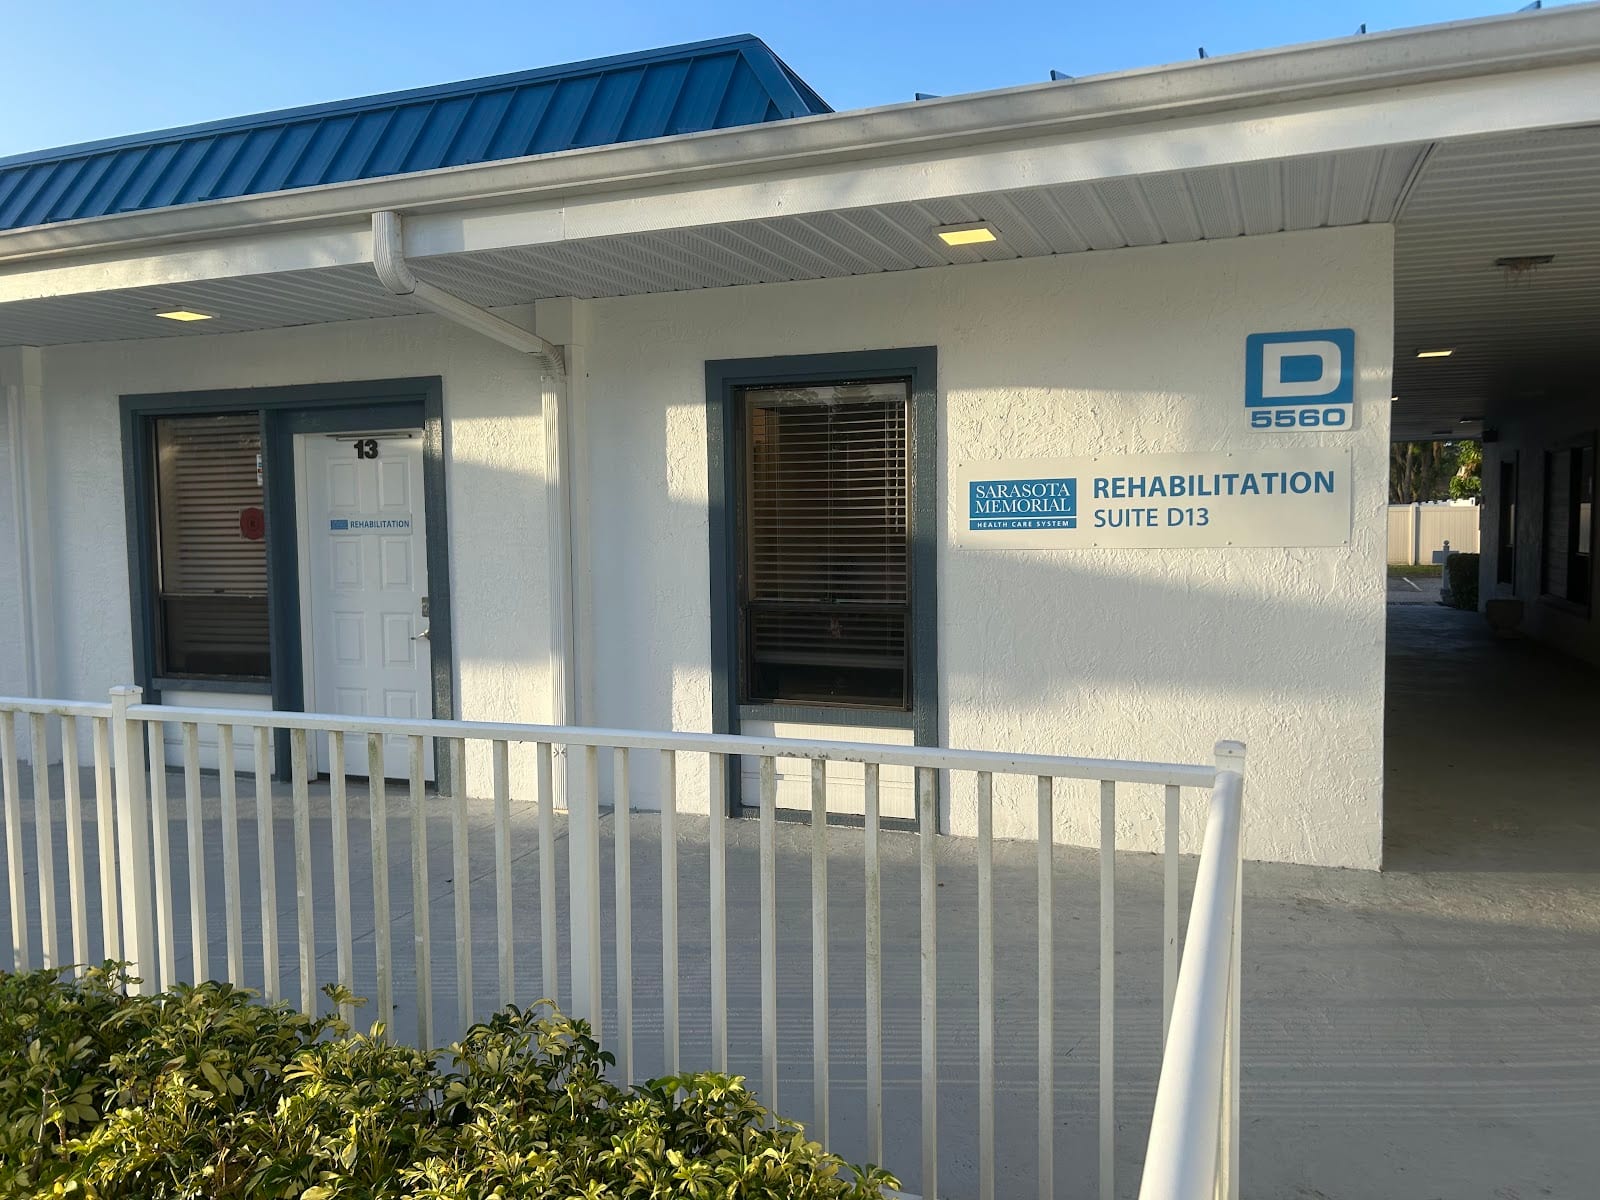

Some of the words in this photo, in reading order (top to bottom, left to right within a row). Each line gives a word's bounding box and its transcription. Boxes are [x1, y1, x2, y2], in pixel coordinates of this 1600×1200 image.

[1262, 340, 1342, 398] D
[1251, 408, 1346, 428] 5560
[353, 439, 379, 459] 13
[975, 482, 1071, 499] SARASOTA
[1093, 471, 1334, 499] REHABILITATION
[975, 498, 1071, 514] MEMORIAL
[350, 520, 410, 528] REHABILITATION
[1094, 509, 1158, 527] SUITE
[1168, 507, 1209, 527] D13
